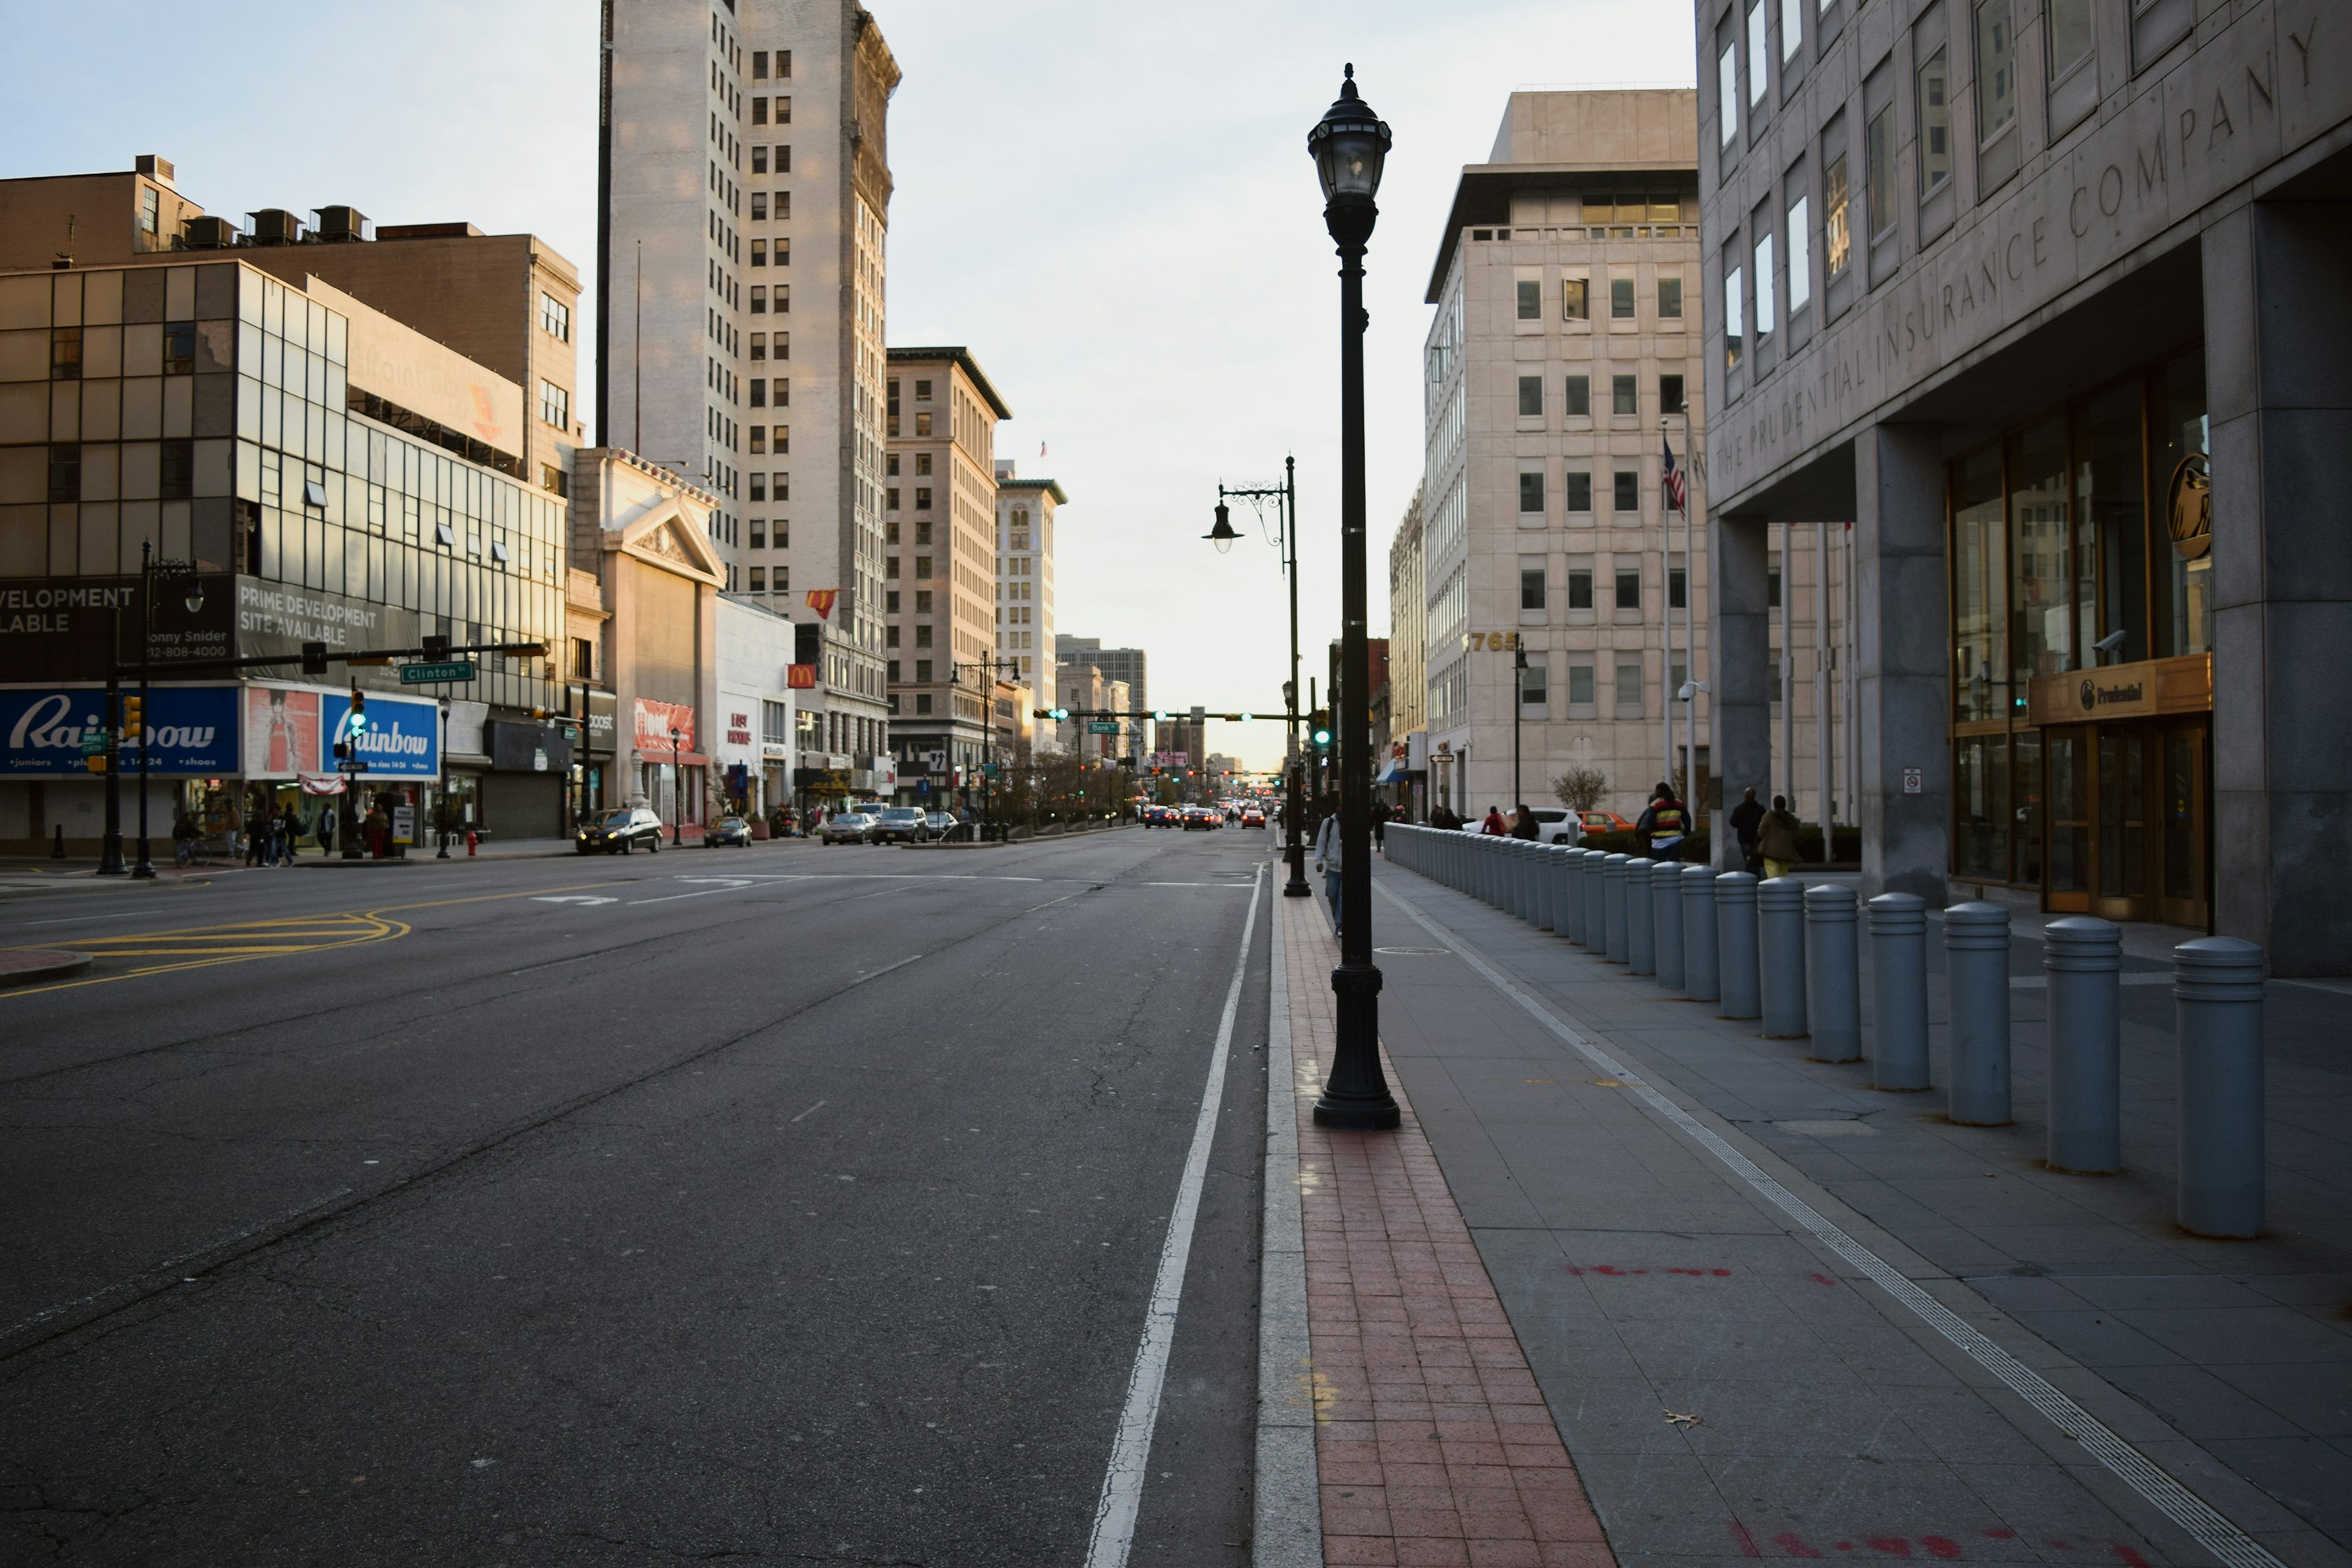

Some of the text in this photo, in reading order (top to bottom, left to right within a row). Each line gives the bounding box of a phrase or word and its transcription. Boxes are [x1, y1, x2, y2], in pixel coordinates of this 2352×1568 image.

[1716, 16, 2318, 479] THE PRUDENTIAL INSURANCE COMPANY
[240, 586, 376, 630] PRIME DEVELOPMENT
[149, 630, 227, 644] onny Snider
[240, 611, 347, 646] SITE AVAILABLE
[1471, 630, 1516, 652] 765
[408, 668, 456, 680] Clinton
[2097, 682, 2142, 704] Prudential
[9, 694, 216, 749] Raiow
